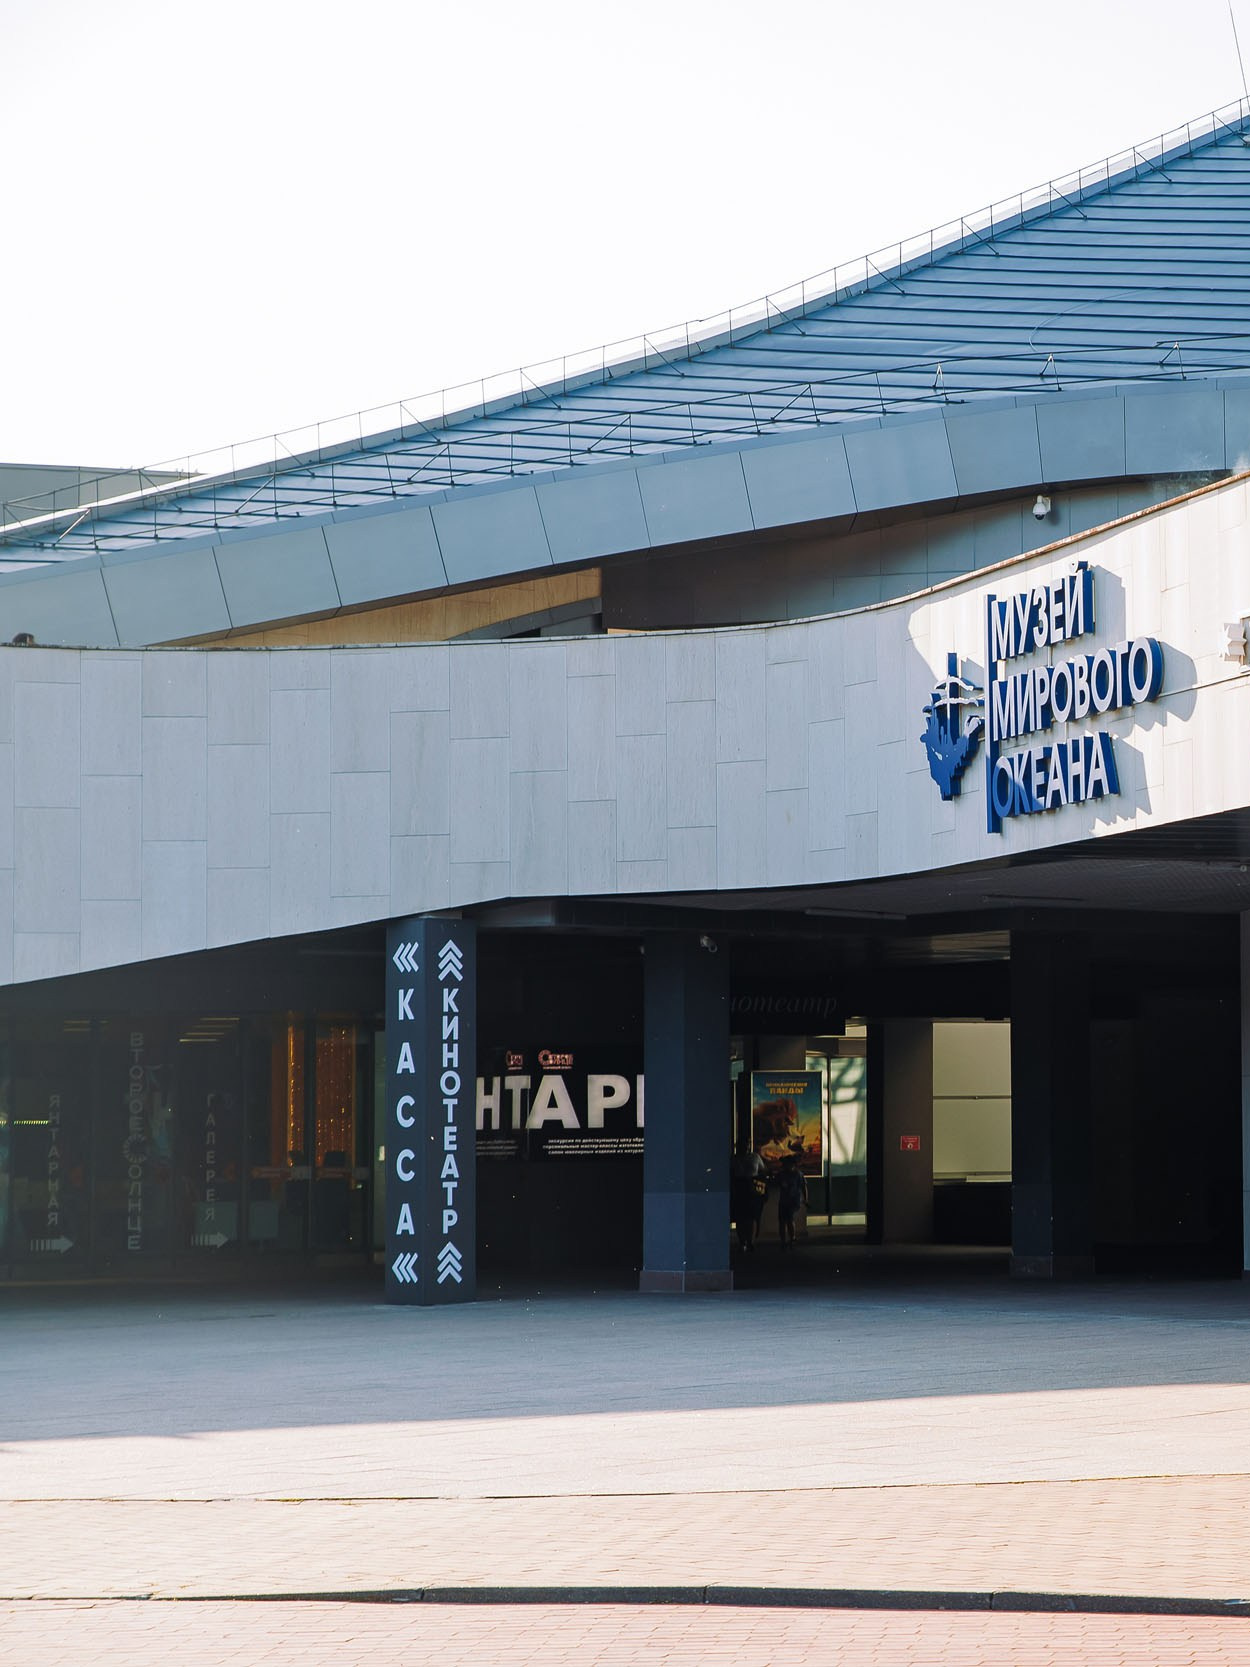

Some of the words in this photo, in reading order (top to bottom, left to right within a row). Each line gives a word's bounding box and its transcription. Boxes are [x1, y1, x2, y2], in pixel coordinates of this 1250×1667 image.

[990, 560, 1096, 664] МУЗЕЙ
[991, 636, 1164, 742] МИРОВОГО
[991, 731, 1121, 818] ОКЕАНА
[47, 1094, 61, 1226] ЯНТАРНАЯ
[205, 1093, 218, 1222] ГАЛЕРЕЯ
[397, 988, 416, 1236] КАССА
[440, 988, 461, 1234] КИНОТЕАТР
